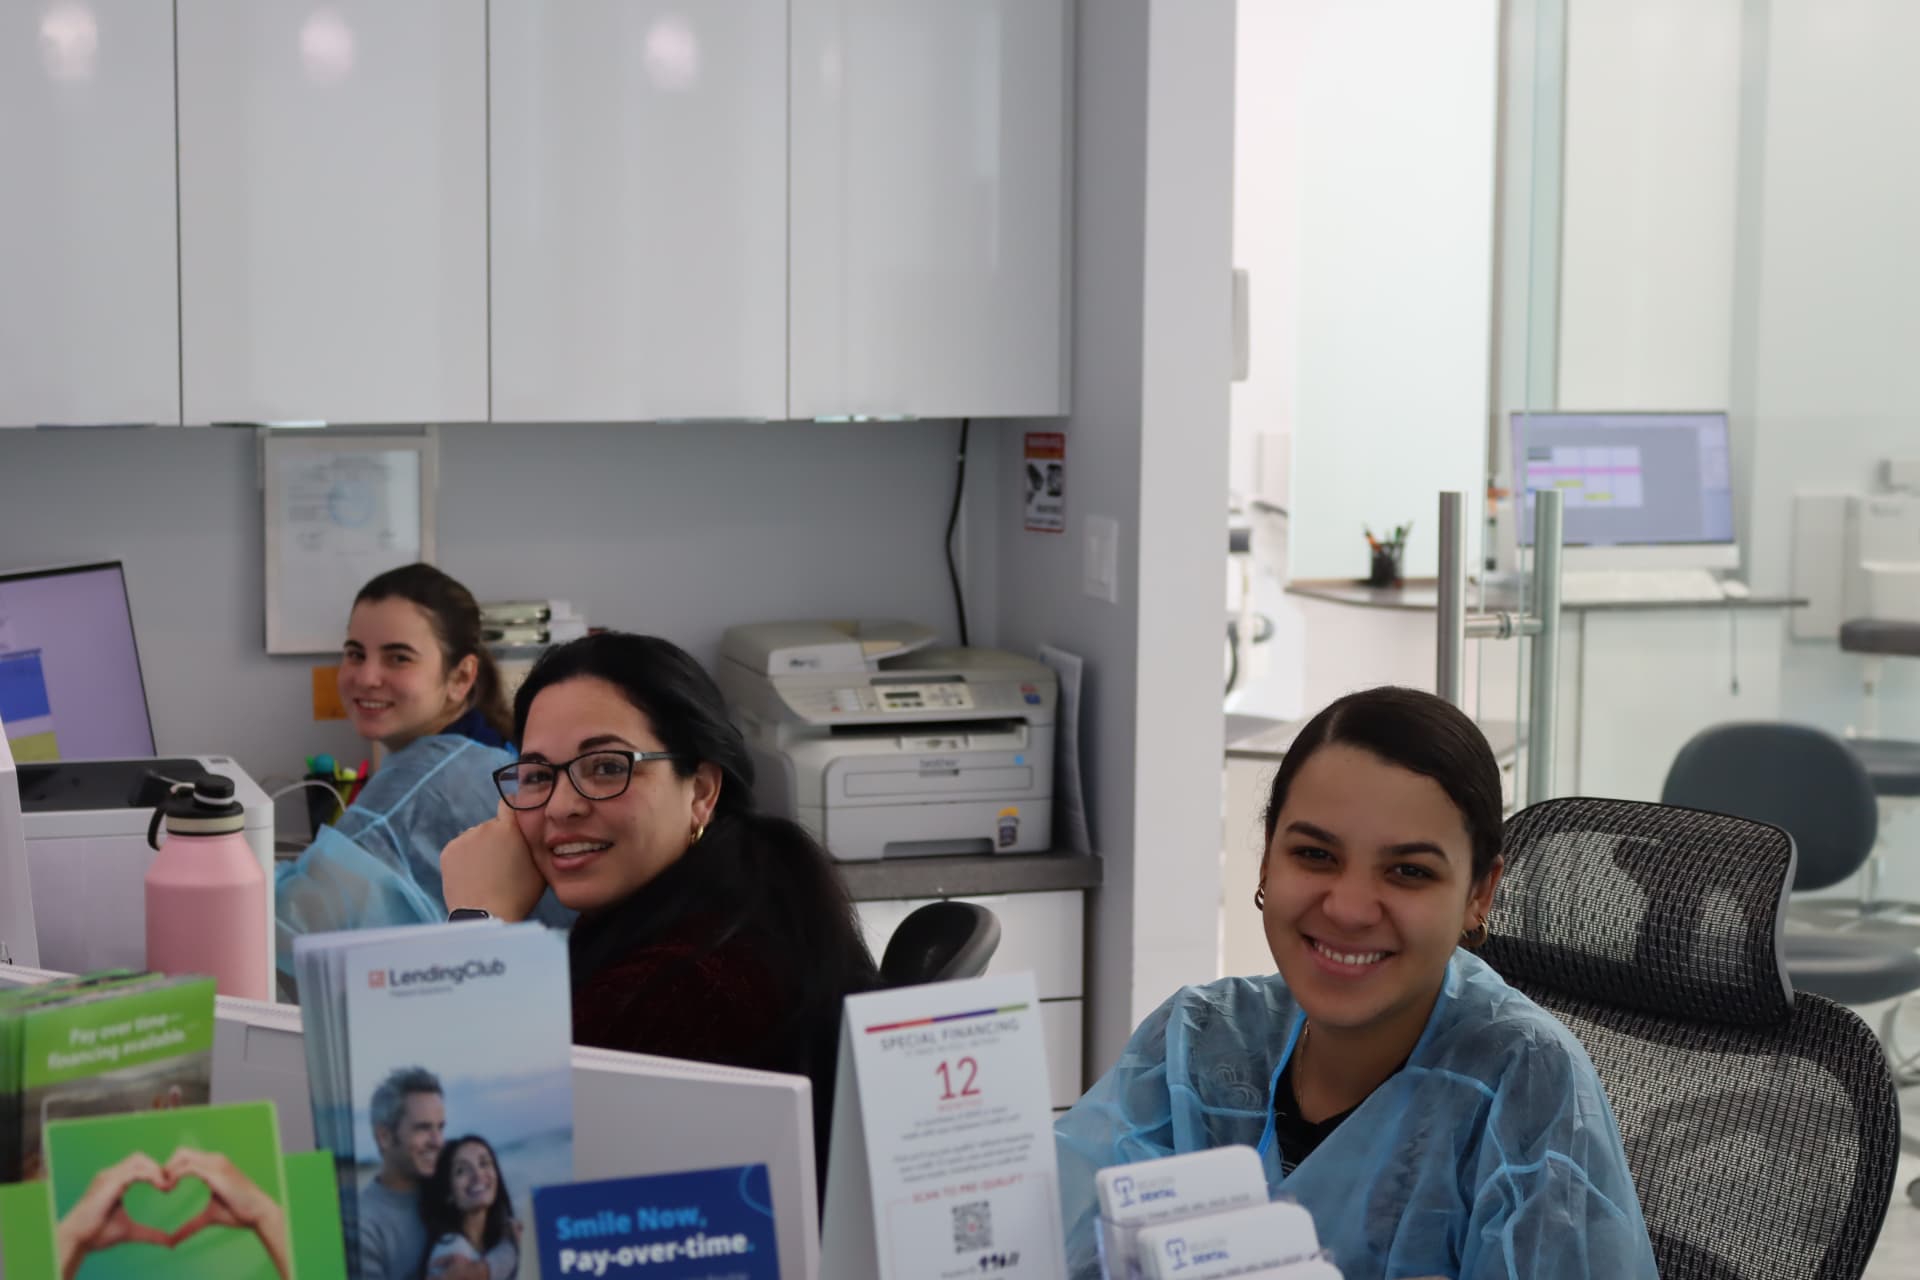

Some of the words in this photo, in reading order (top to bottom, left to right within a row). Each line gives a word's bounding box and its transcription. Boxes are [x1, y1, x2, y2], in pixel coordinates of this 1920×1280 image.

[389, 956, 506, 987] LendingClub
[69, 1027, 97, 1045] Pay
[100, 1022, 132, 1040] over
[880, 1032, 937, 1051] SPECIAL
[941, 1017, 1020, 1041] FINANCING
[935, 1055, 981, 1100] 12
[556, 1211, 632, 1240] Smile
[637, 1206, 708, 1231] Now,
